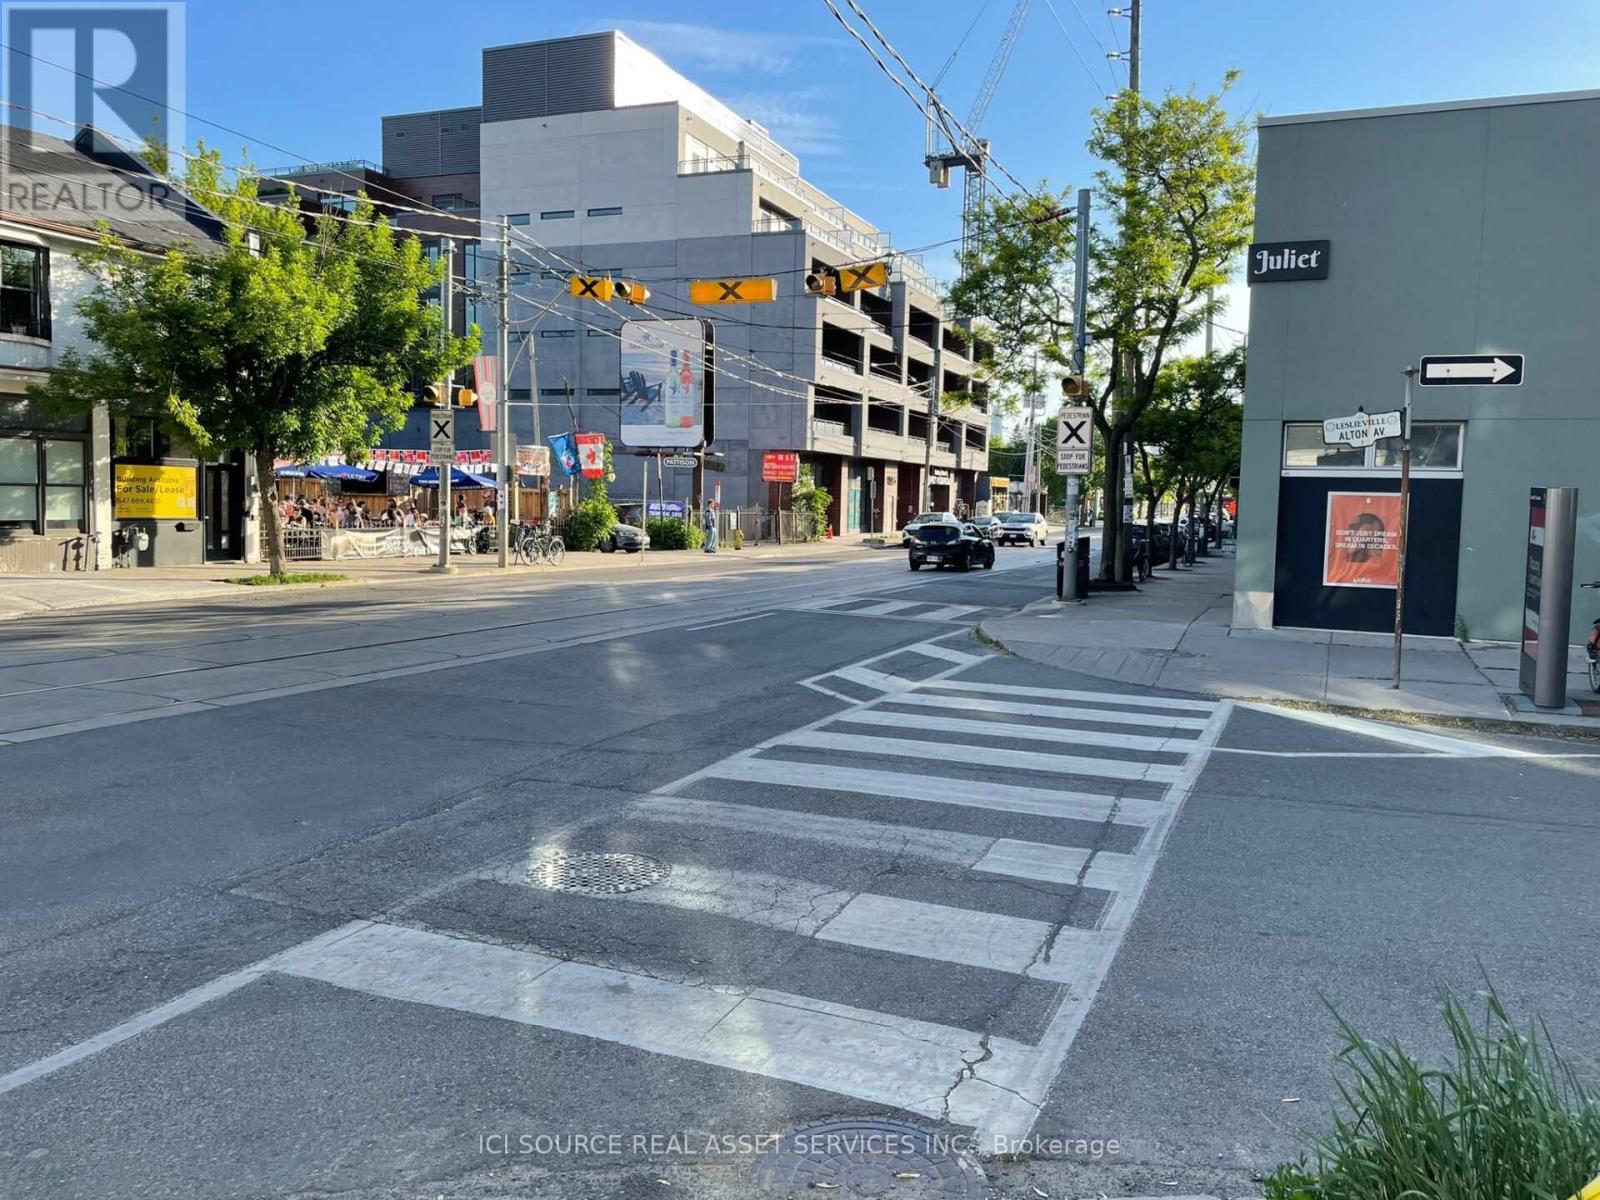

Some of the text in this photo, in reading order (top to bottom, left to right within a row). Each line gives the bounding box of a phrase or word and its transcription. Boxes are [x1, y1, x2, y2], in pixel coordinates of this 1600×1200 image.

[1254, 248, 1321, 275] Juliet
[1336, 417, 1386, 430] LESLIEVILLE
[1339, 427, 1385, 440] ALTON AV
[117, 485, 184, 494] For Sale/Lease
